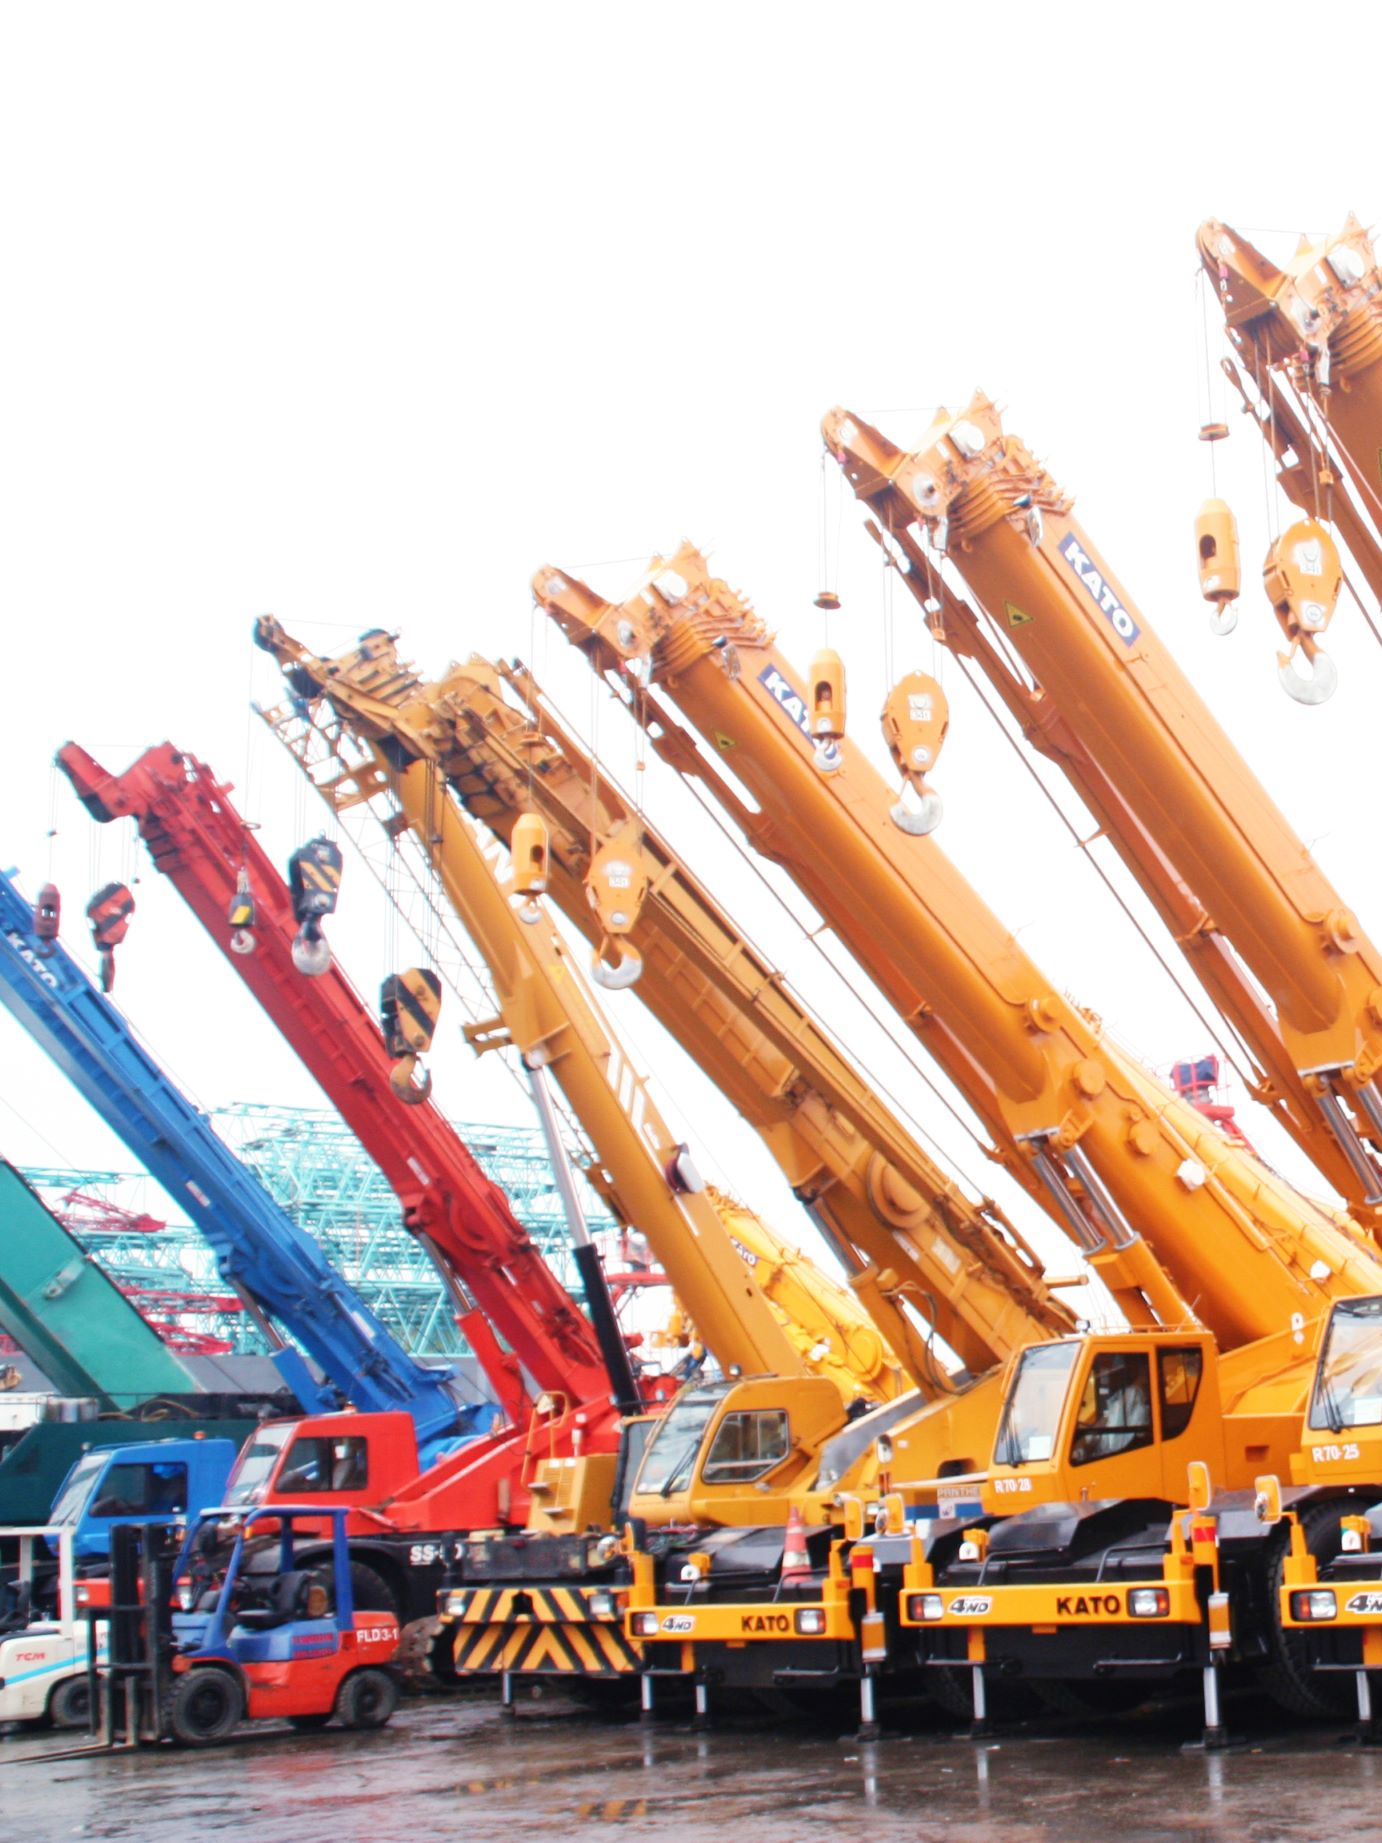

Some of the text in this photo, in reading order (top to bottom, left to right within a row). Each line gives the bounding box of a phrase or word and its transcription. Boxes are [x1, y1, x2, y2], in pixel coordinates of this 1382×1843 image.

[1064, 541, 1134, 638] KATO
[7, 931, 58, 989] KATO
[950, 1598, 990, 1614] 4WD
[1056, 1594, 1122, 1616] KATO
[662, 1615, 693, 1631] 4WD
[741, 1614, 790, 1633] KATO
[15, 1652, 47, 1662] TCM
